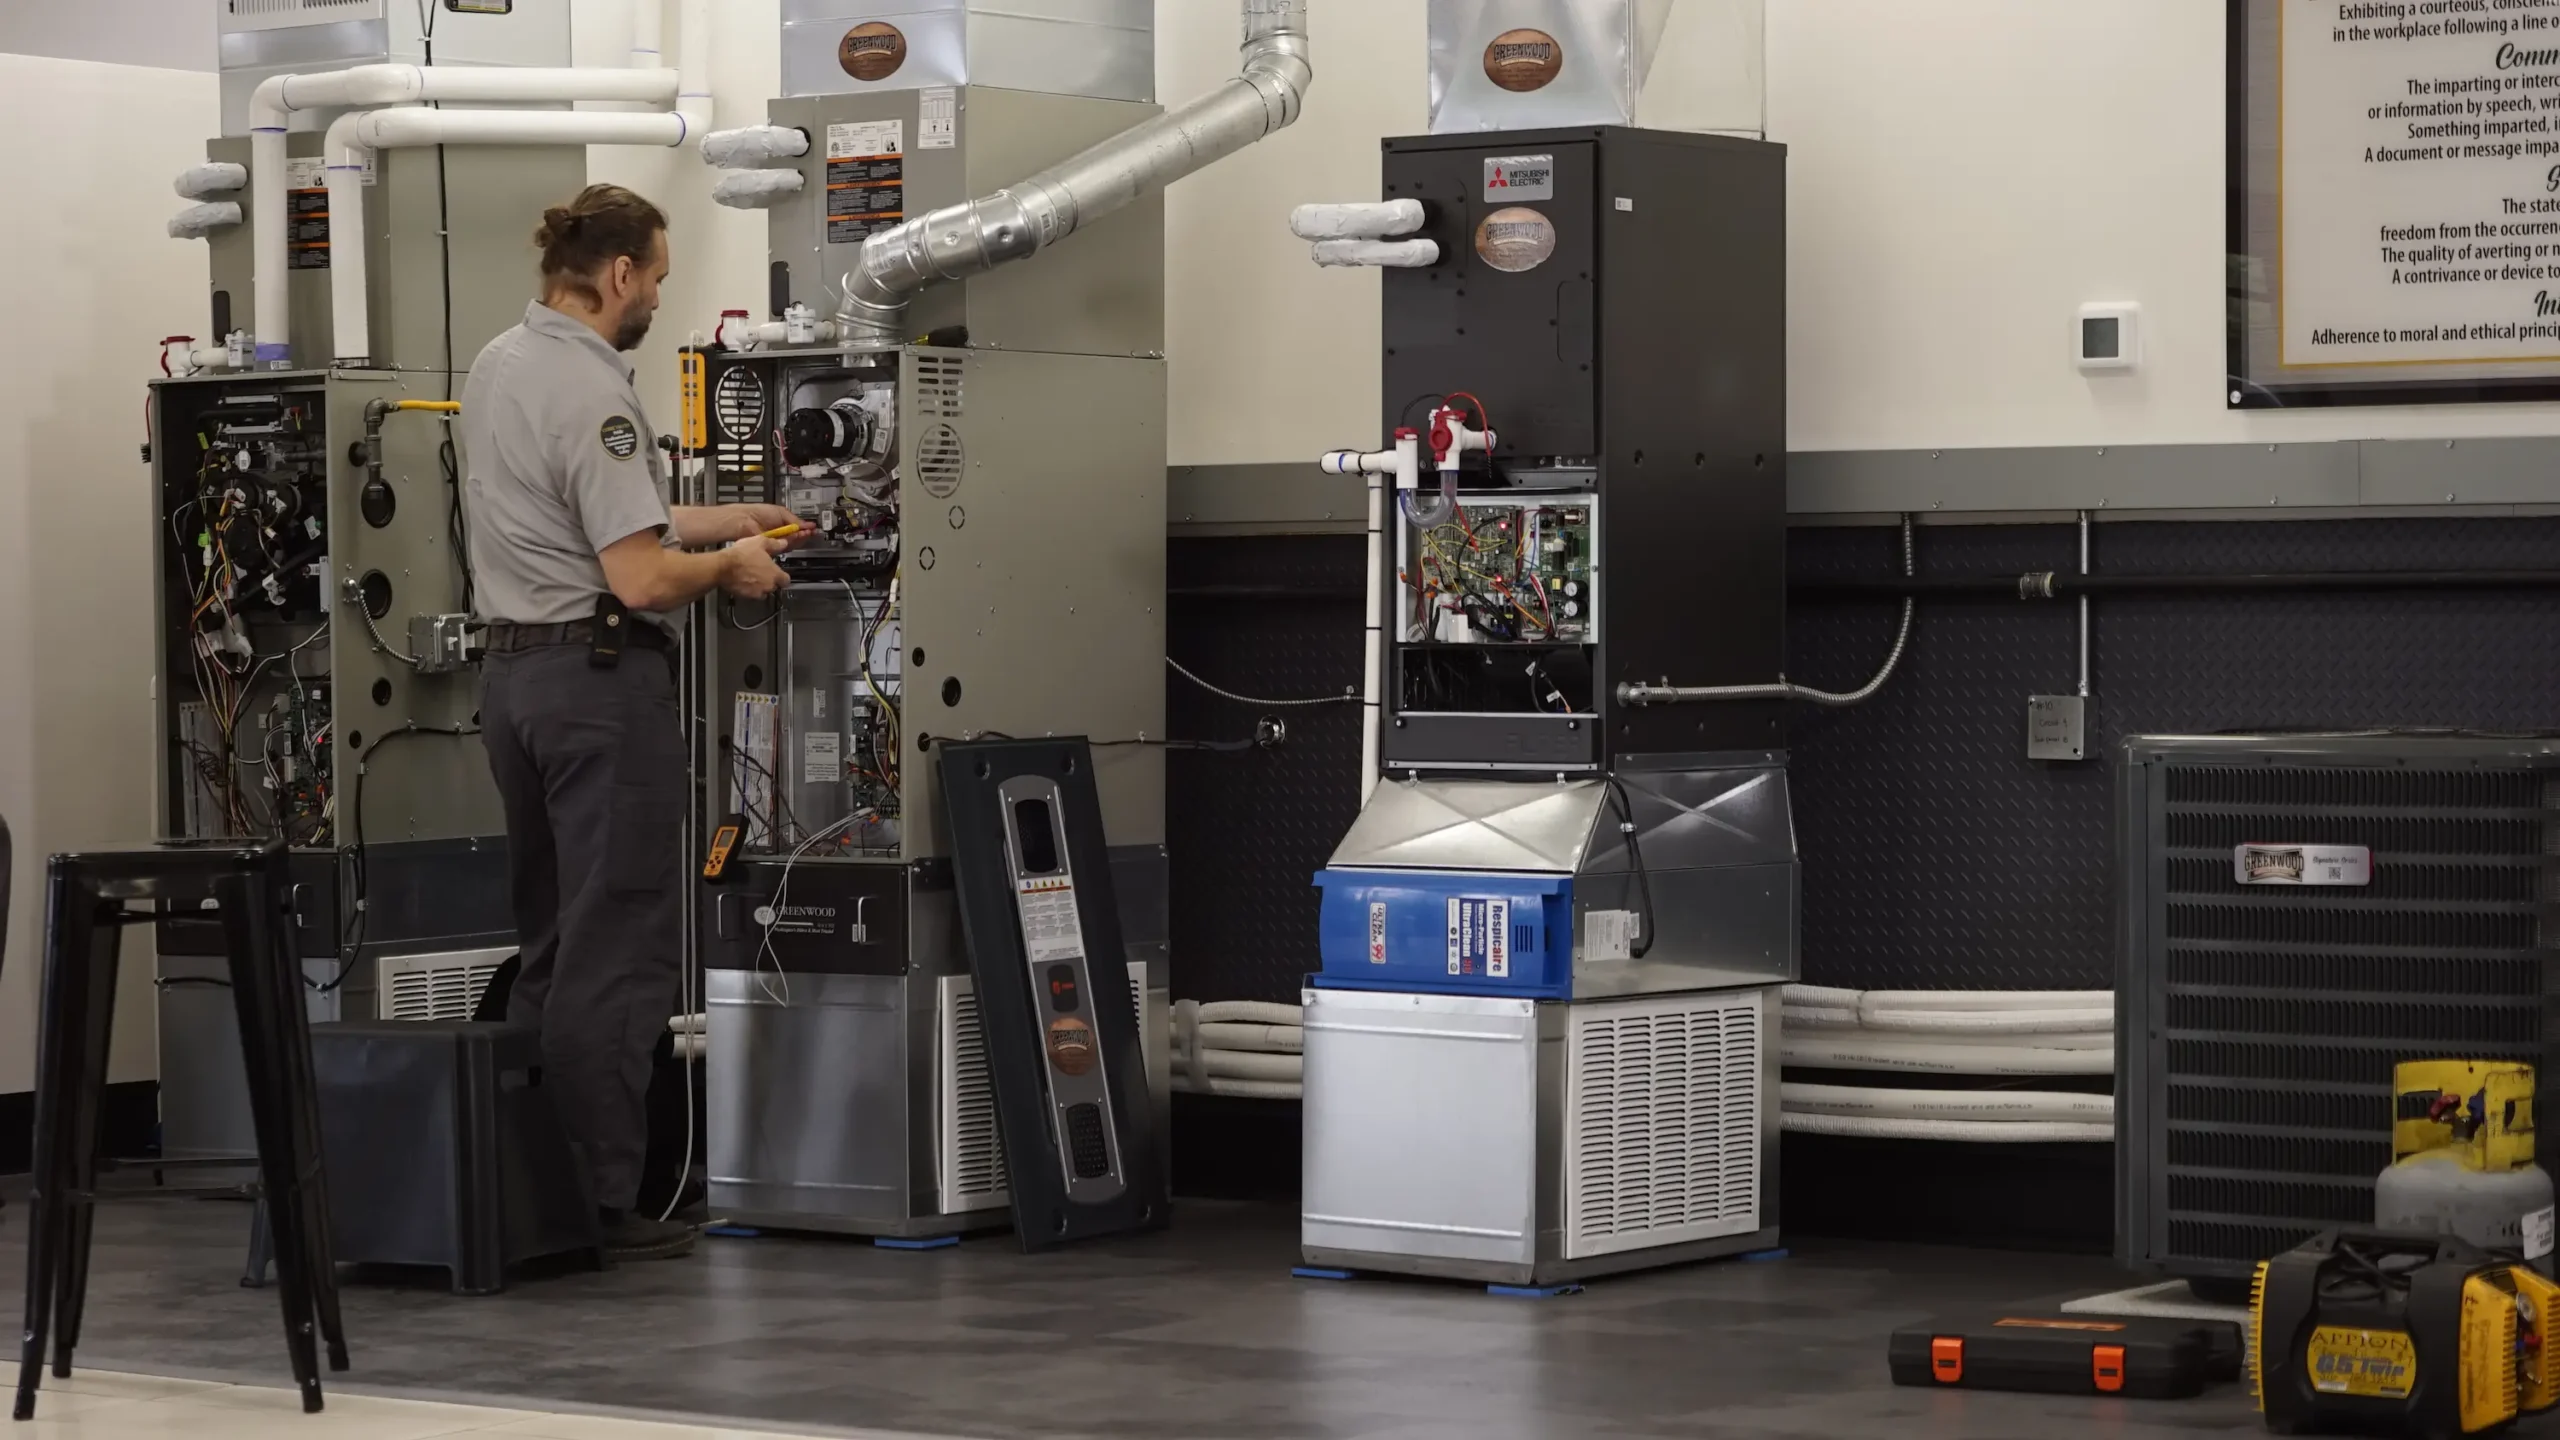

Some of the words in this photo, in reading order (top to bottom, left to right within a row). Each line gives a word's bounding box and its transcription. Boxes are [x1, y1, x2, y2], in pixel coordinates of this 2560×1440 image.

[2339, 2, 2405, 21] Exhibiting
[2408, 4, 2416, 16] a
[2420, 0, 2488, 15] courteous,
[2333, 27, 2345, 42] in
[2349, 25, 2370, 41] the
[2373, 21, 2441, 42] workplace
[2444, 17, 2507, 36] following
[2511, 19, 2519, 31] a
[2523, 14, 2548, 30] line
[848, 35, 897, 53] GREENWOOD
[1494, 43, 1551, 61] GREENWOOD
[2407, 79, 2431, 95] The
[2434, 76, 2501, 97] imparting
[2504, 78, 2518, 90] or
[2368, 107, 2382, 120] or
[2385, 101, 2463, 118] information
[2467, 98, 2482, 117] by
[2486, 95, 2536, 116] speech,
[2408, 121, 2480, 140] Something
[2484, 116, 2550, 138] imparted,
[2364, 147, 2374, 163] A
[2376, 145, 2443, 162] document
[2446, 146, 2460, 159] or
[2464, 143, 2522, 160] message
[2525, 139, 2559, 158] impa
[1510, 169, 1549, 177] MITSUBISHI
[1510, 178, 1544, 186] ELECTRIC
[2502, 198, 2526, 214] The
[1486, 223, 1544, 240] GREENWOOD
[2380, 224, 2436, 242] freedom
[2439, 222, 2471, 239] from
[2474, 221, 2497, 237] the
[2500, 222, 2560, 236] occurren
[2381, 247, 2405, 263] The
[2408, 245, 2455, 266] quality
[2458, 244, 2472, 260] of
[2475, 242, 2531, 262] averting
[2535, 245, 2549, 257] or
[2392, 268, 2401, 284] A
[2404, 267, 2481, 284] contrivance
[2484, 269, 2498, 281] or
[2501, 264, 2544, 280] device
[2311, 328, 2380, 345] Adherence
[2383, 328, 2397, 343] to
[2400, 324, 2438, 342] moral
[2442, 324, 2467, 341] and
[2470, 322, 2515, 340] ethical
[2245, 854, 2304, 871] GREENWOOD
[776, 906, 835, 917] GREENWOOD
[1463, 903, 1472, 957] UltraClean
[1492, 905, 1503, 972] Respicaire
[2311, 1332, 2408, 1349] APPION
